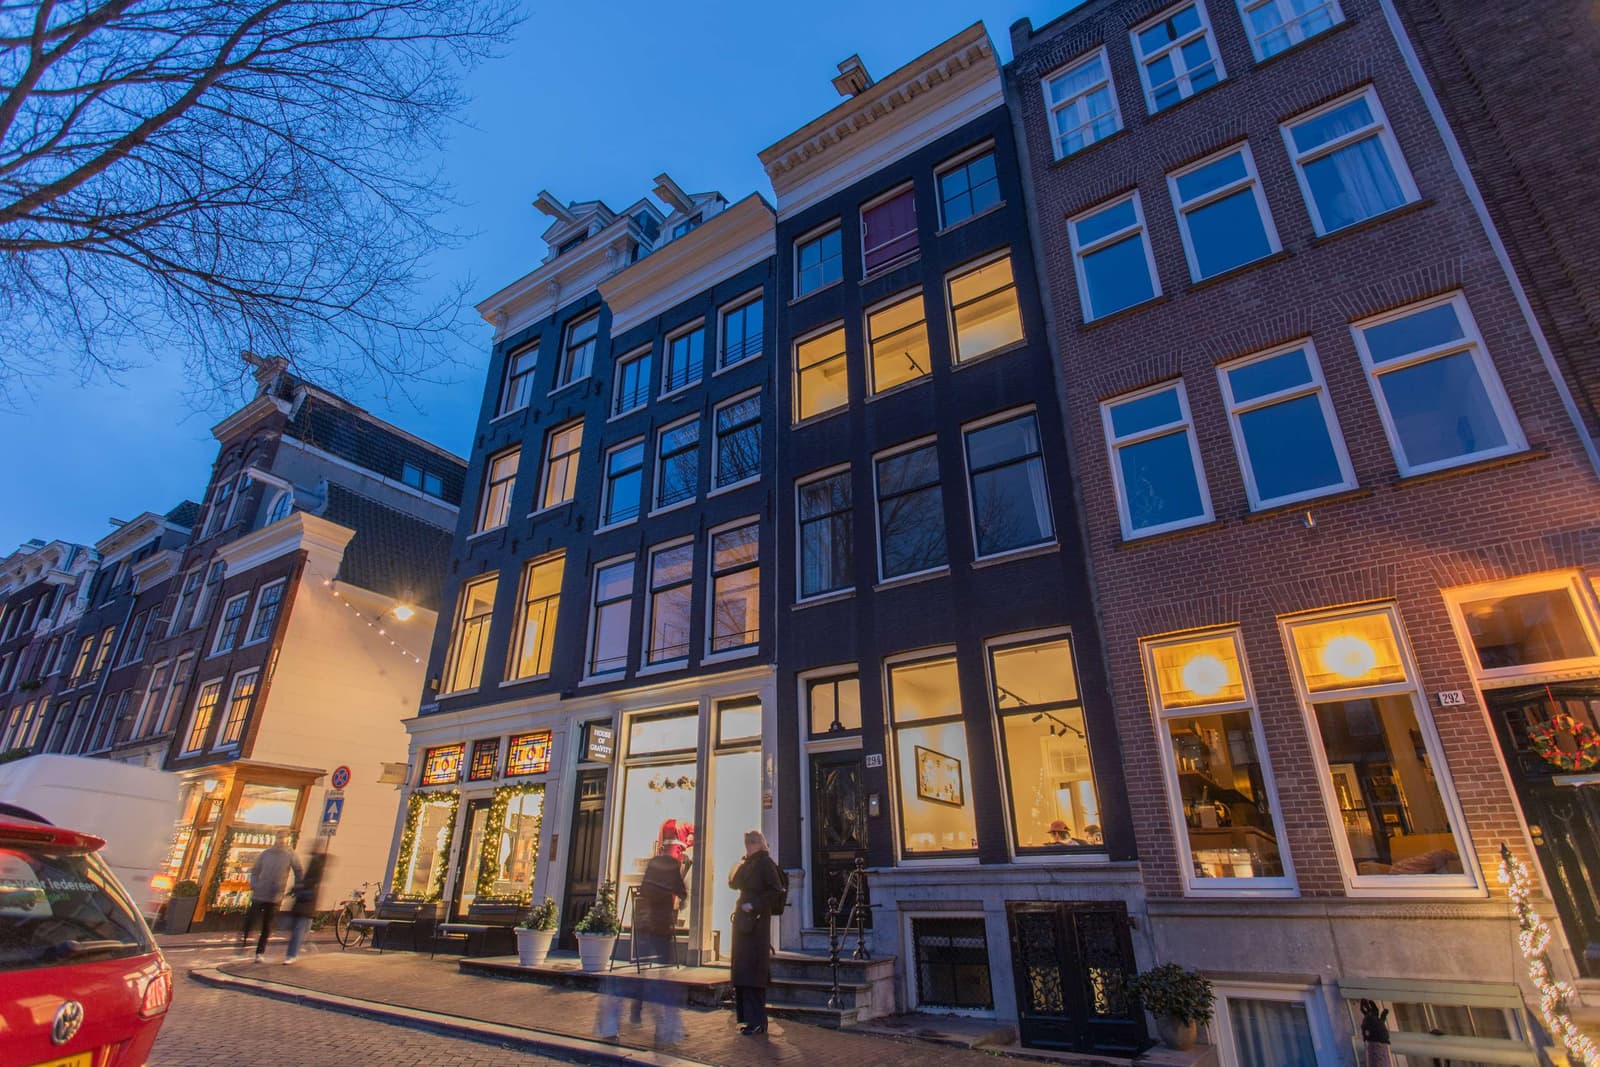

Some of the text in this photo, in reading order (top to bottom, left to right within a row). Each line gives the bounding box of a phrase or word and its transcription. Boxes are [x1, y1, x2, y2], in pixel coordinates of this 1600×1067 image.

[1441, 692, 1460, 704] 292
[593, 729, 612, 739] HOUSE
[597, 737, 606, 745] OF
[589, 743, 613, 755] GRAVITY
[867, 755, 882, 766] 294
[47, 878, 99, 892] iedereen
